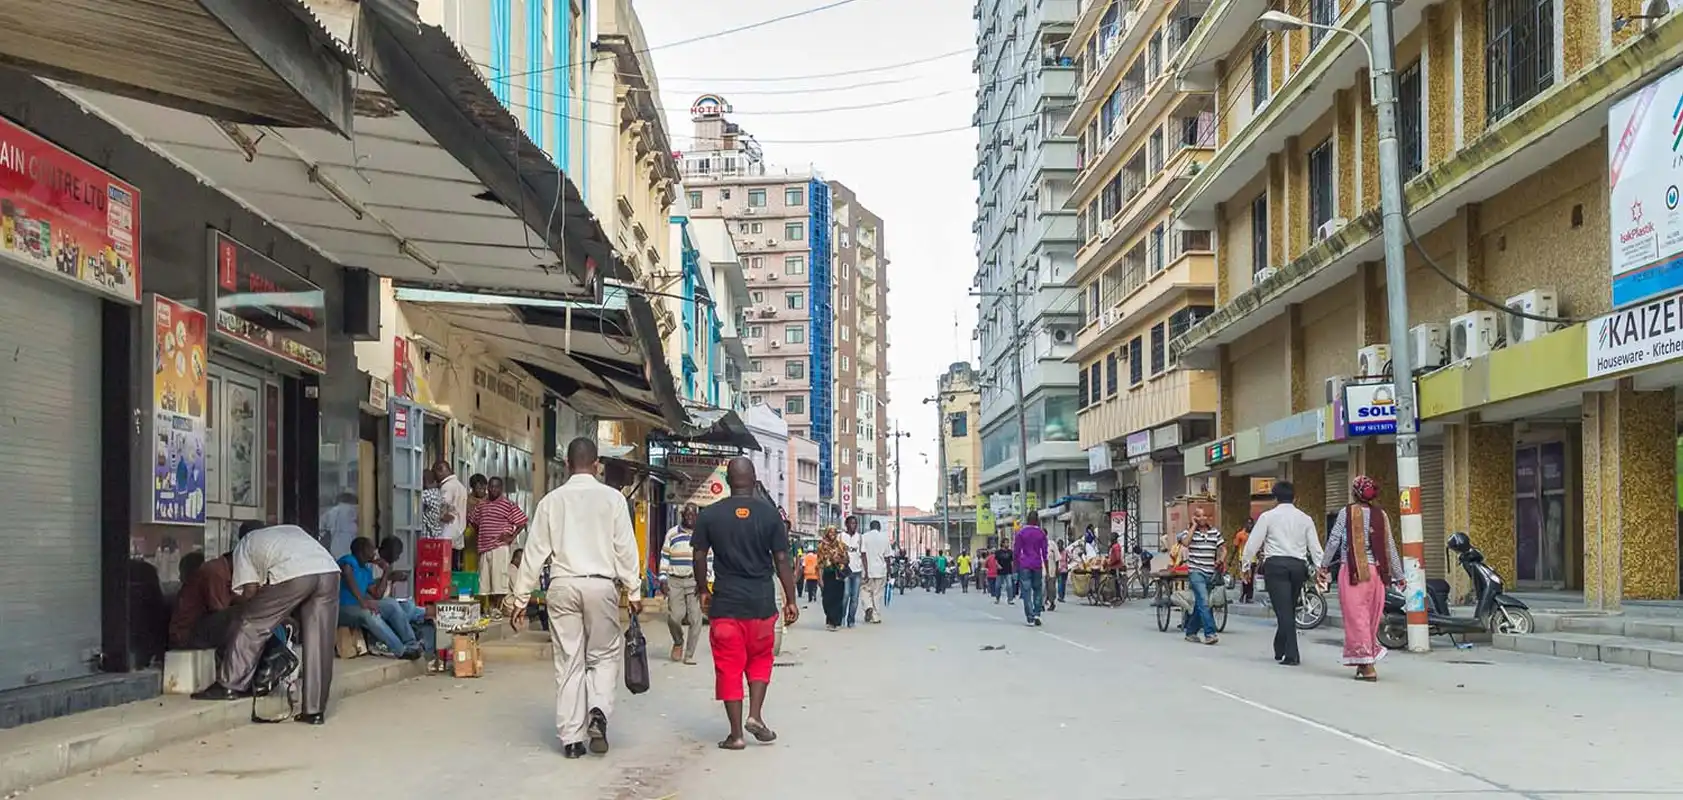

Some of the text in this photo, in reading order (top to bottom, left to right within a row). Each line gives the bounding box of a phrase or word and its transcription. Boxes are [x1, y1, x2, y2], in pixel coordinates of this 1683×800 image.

[690, 105, 726, 114] HOTEL
[1597, 349, 1644, 371] Houseware
[1358, 406, 1397, 417] SOLE
